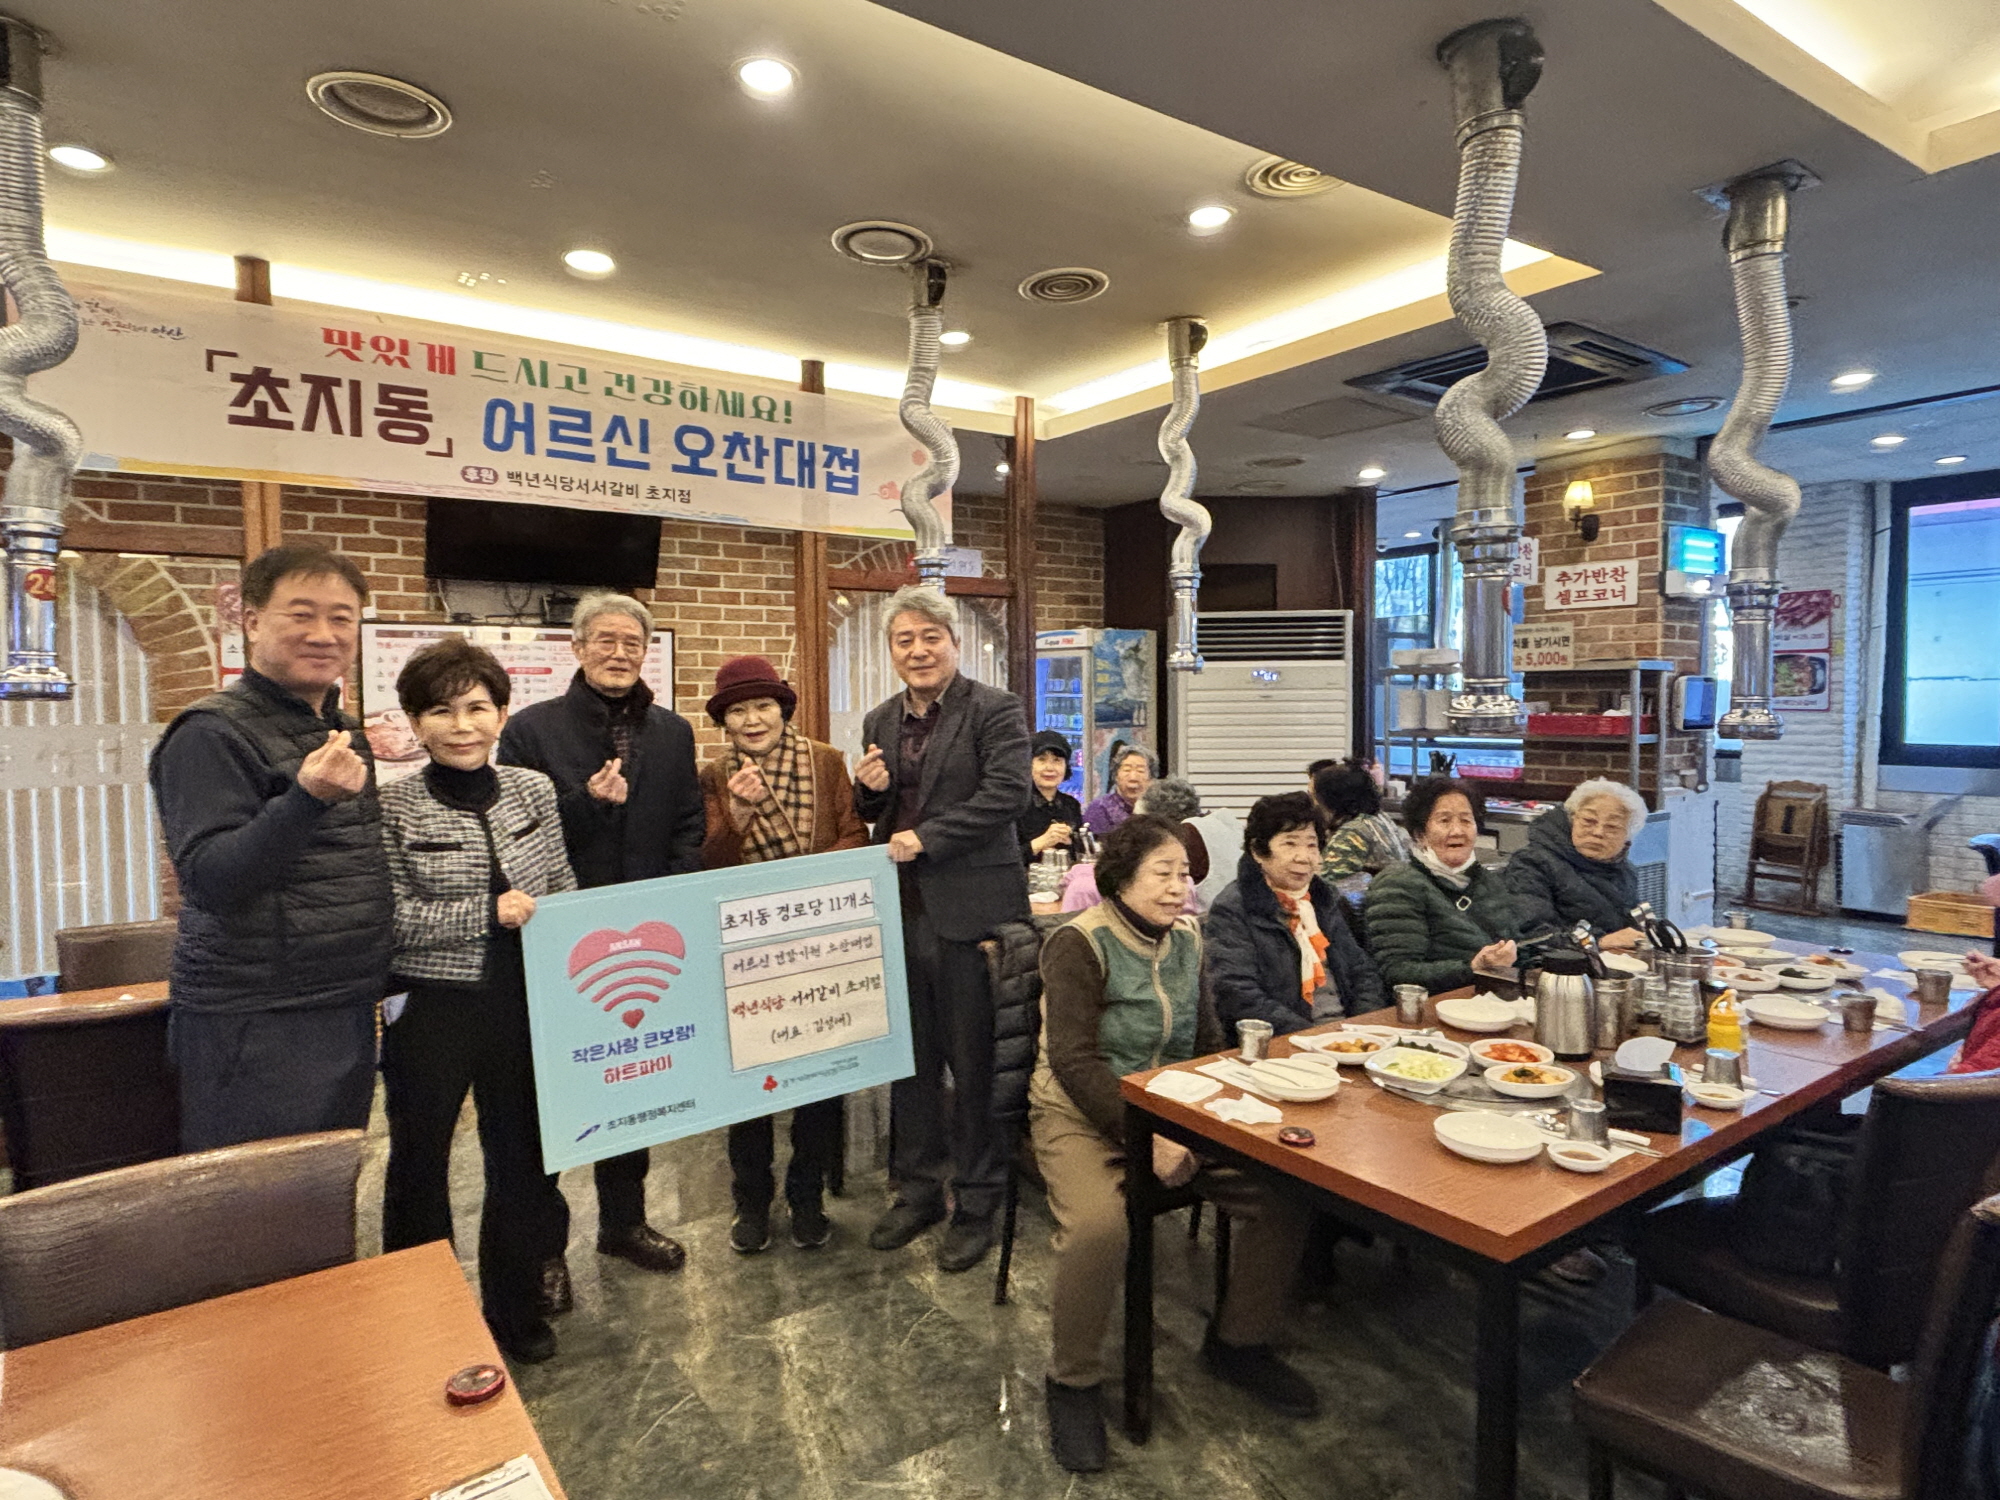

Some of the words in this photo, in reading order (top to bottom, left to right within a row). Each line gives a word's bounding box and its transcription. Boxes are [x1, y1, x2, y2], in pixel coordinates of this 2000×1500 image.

[321, 327, 456, 376] 맛있게
[471, 349, 590, 394] 드시고
[603, 370, 793, 425] 건강하세요!
[482, 398, 650, 471] 어르신
[672, 424, 860, 496] 오찬대접
[463, 467, 496, 483] 후원
[507, 470, 639, 499] 백년식당서서갈비
[645, 484, 692, 504] 초지점
[1555, 566, 1629, 587] 추가반찬
[1555, 585, 1627, 606] 셀프코너
[1534, 636, 1570, 649] 남기시면
[1526, 652, 1568, 668] 5,000원
[722, 908, 771, 930] 초지동
[777, 899, 823, 922] 경로당
[830, 891, 874, 912] 11개소
[733, 954, 770, 974] 어르신
[731, 994, 786, 1019] 백년식당
[790, 983, 841, 1006] 서서갈비
[846, 974, 882, 995] 초지점
[571, 1036, 639, 1064] 작은사랑
[643, 1024, 696, 1050] 큰보람!
[603, 1054, 673, 1085] 하트파이
[606, 1099, 696, 1131] 초지동행정복지센터
